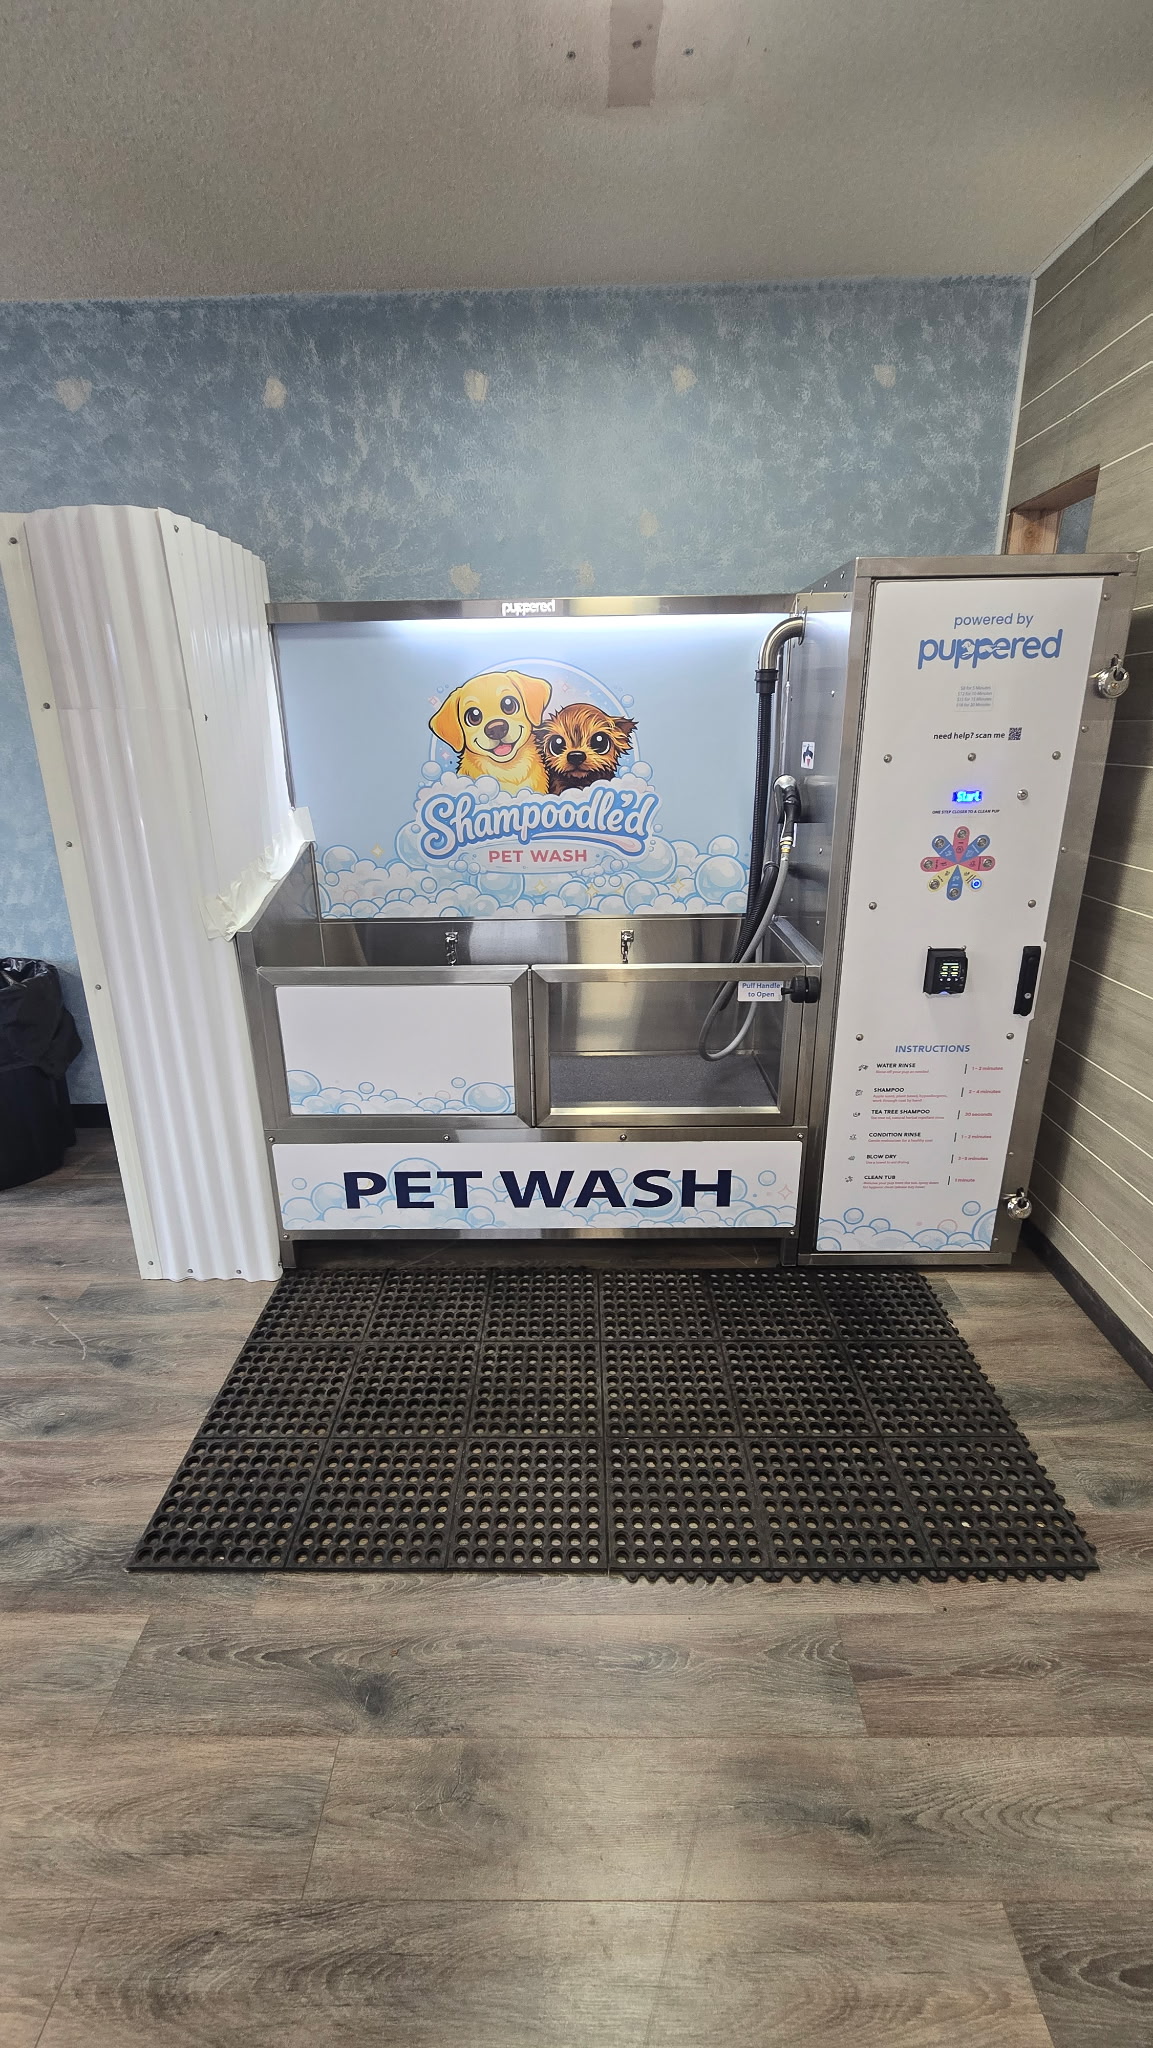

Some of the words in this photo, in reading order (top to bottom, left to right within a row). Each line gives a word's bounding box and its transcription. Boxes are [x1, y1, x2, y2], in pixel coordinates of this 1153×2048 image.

[501, 599, 556, 616] puppered
[953, 613, 1013, 629] powered
[1016, 613, 1034, 628] by
[917, 629, 1063, 670] puppered
[953, 732, 974, 740] help?
[957, 791, 981, 803] Start
[488, 850, 523, 863] PET
[530, 849, 587, 862] WASH
[895, 1044, 971, 1053] INSTRUCTIONS
[343, 1170, 483, 1210] PET
[499, 1168, 733, 1209] WASH
